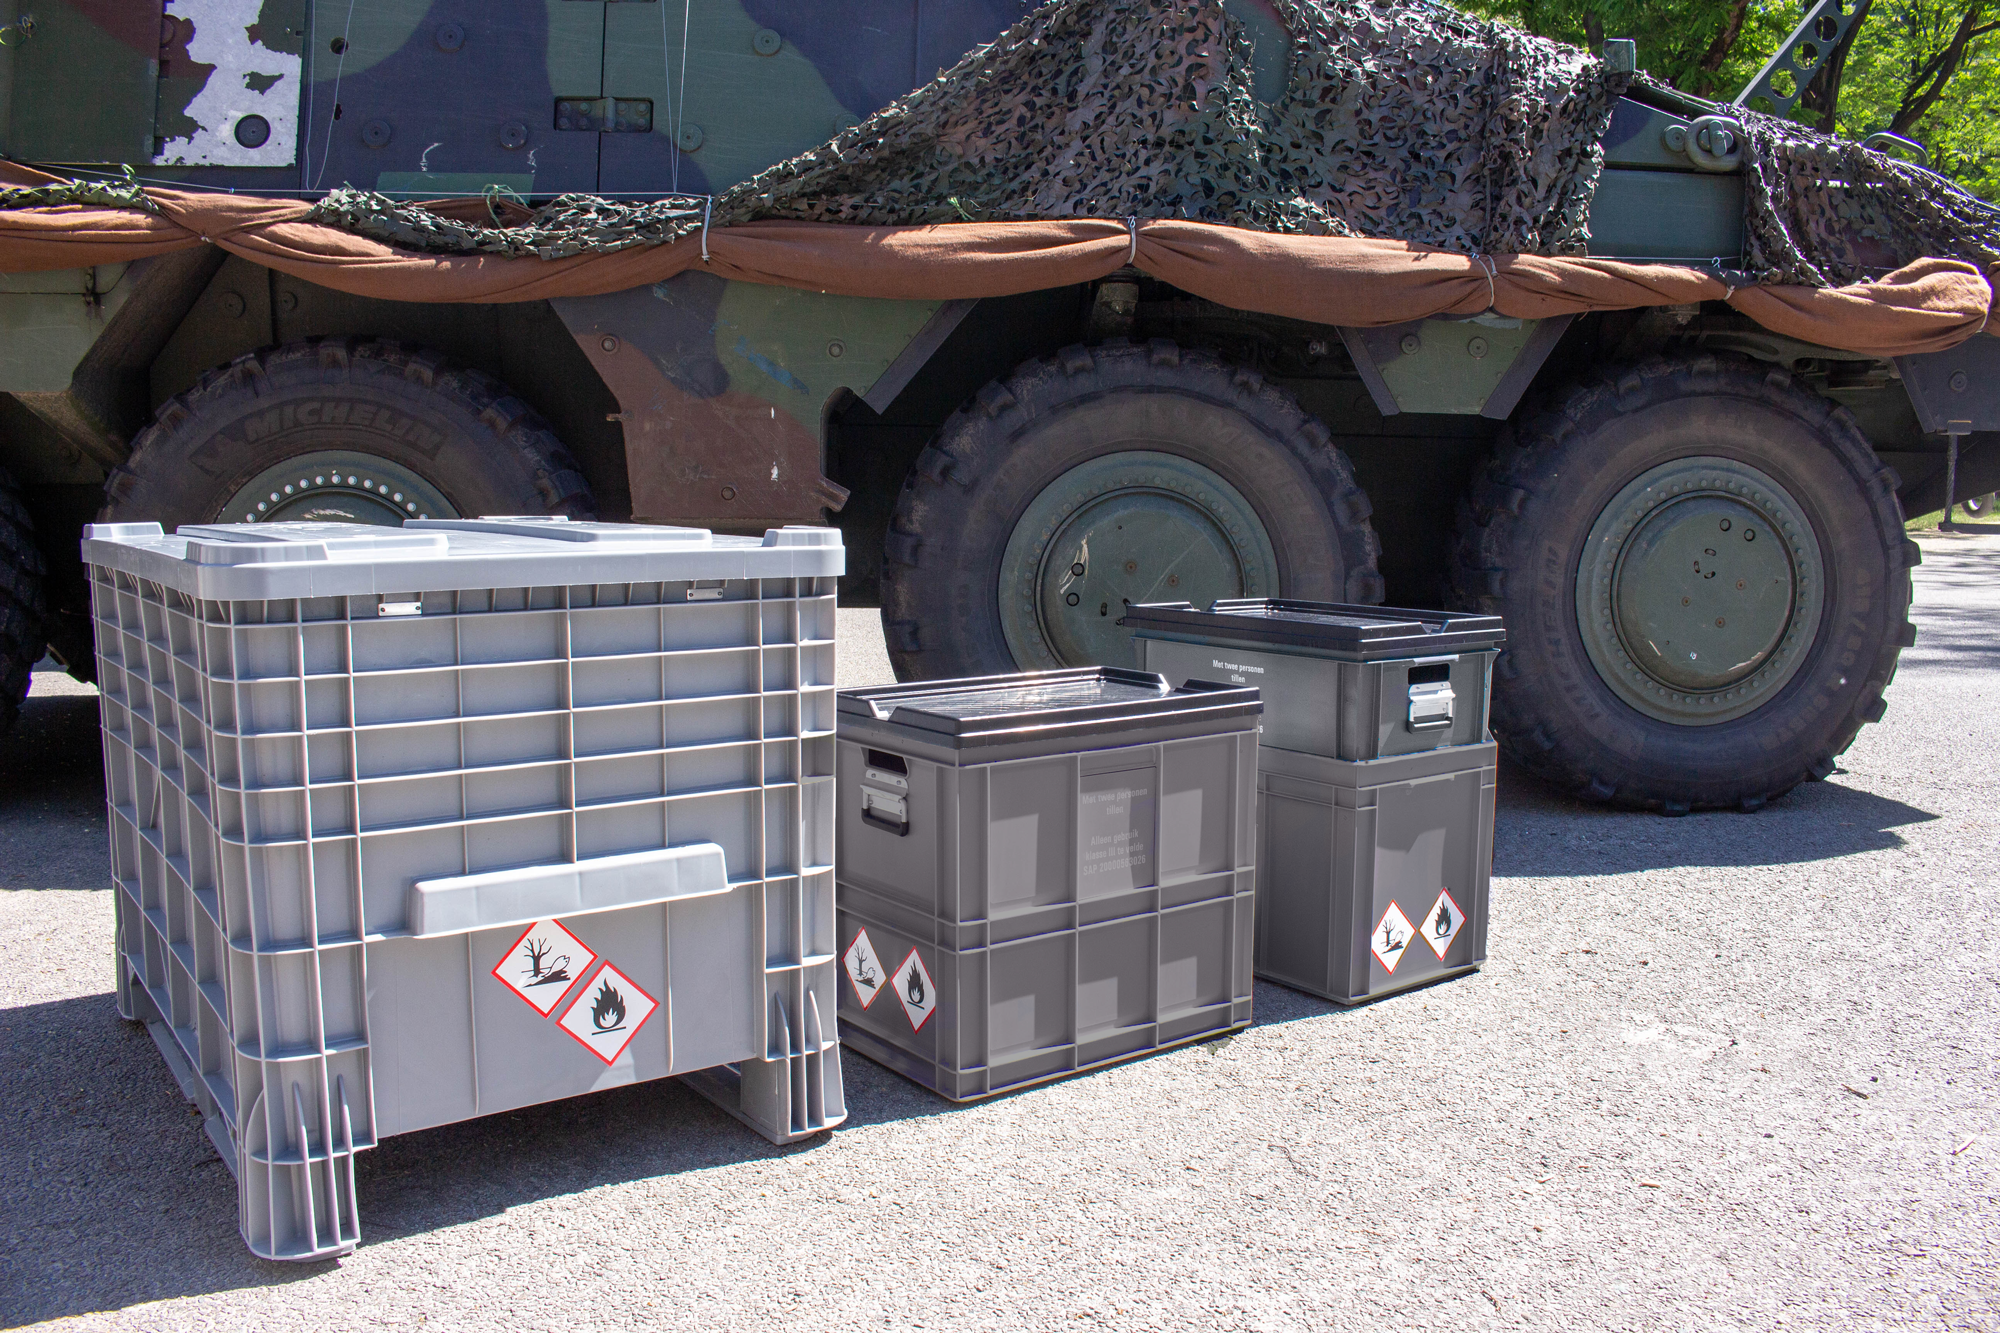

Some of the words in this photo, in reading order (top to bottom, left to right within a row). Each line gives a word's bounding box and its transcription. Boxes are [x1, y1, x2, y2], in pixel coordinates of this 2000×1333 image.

[243, 400, 444, 450] MICHELIN
[1541, 545, 1601, 723] MICHELIN
[1212, 659, 1224, 669] Met
[1224, 661, 1238, 671] twee
[1239, 665, 1264, 674] personen
[1231, 674, 1246, 683] tillen
[1082, 795, 1097, 805] Met
[1098, 792, 1115, 802] twee
[1116, 789, 1147, 801] personen
[1106, 804, 1124, 815] tillen
[1090, 834, 1112, 846] Alleen
[1113, 829, 1139, 843] gebruik
[1085, 850, 1107, 861] klasse
[1117, 846, 1125, 855] te
[1125, 842, 1144, 854] velde
[1083, 864, 1098, 876] SAP
